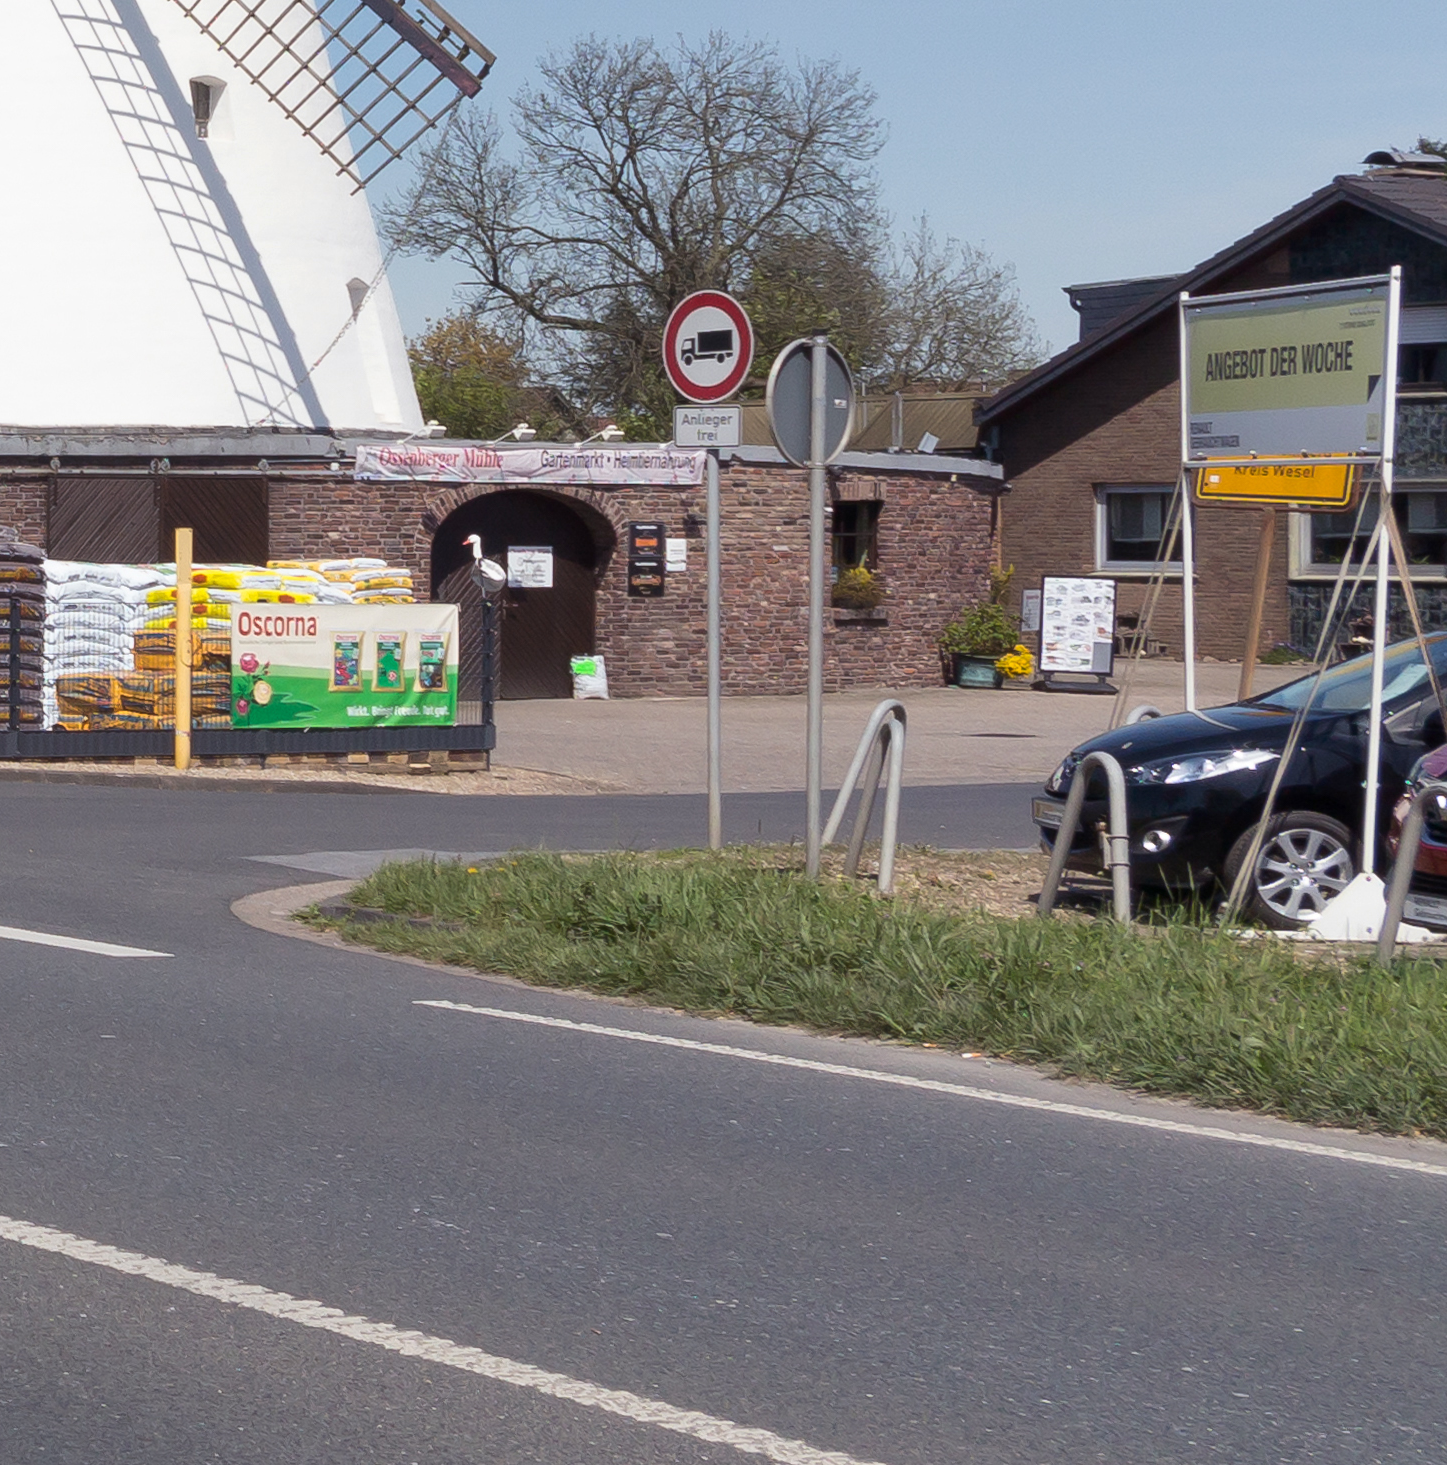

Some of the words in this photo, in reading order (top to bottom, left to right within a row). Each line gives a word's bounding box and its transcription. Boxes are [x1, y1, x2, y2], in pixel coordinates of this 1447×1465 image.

[1205, 348, 1267, 382] ANGEBOT
[1269, 345, 1298, 377] DER
[1301, 340, 1354, 374] WOCHE
[681, 413, 734, 428] Anlieger
[697, 428, 718, 441] frei
[463, 447, 504, 469] Mühle
[540, 450, 604, 468] Gartenmarkt
[613, 451, 697, 474] Heimtiernahrung
[238, 612, 317, 636] Oscorna
